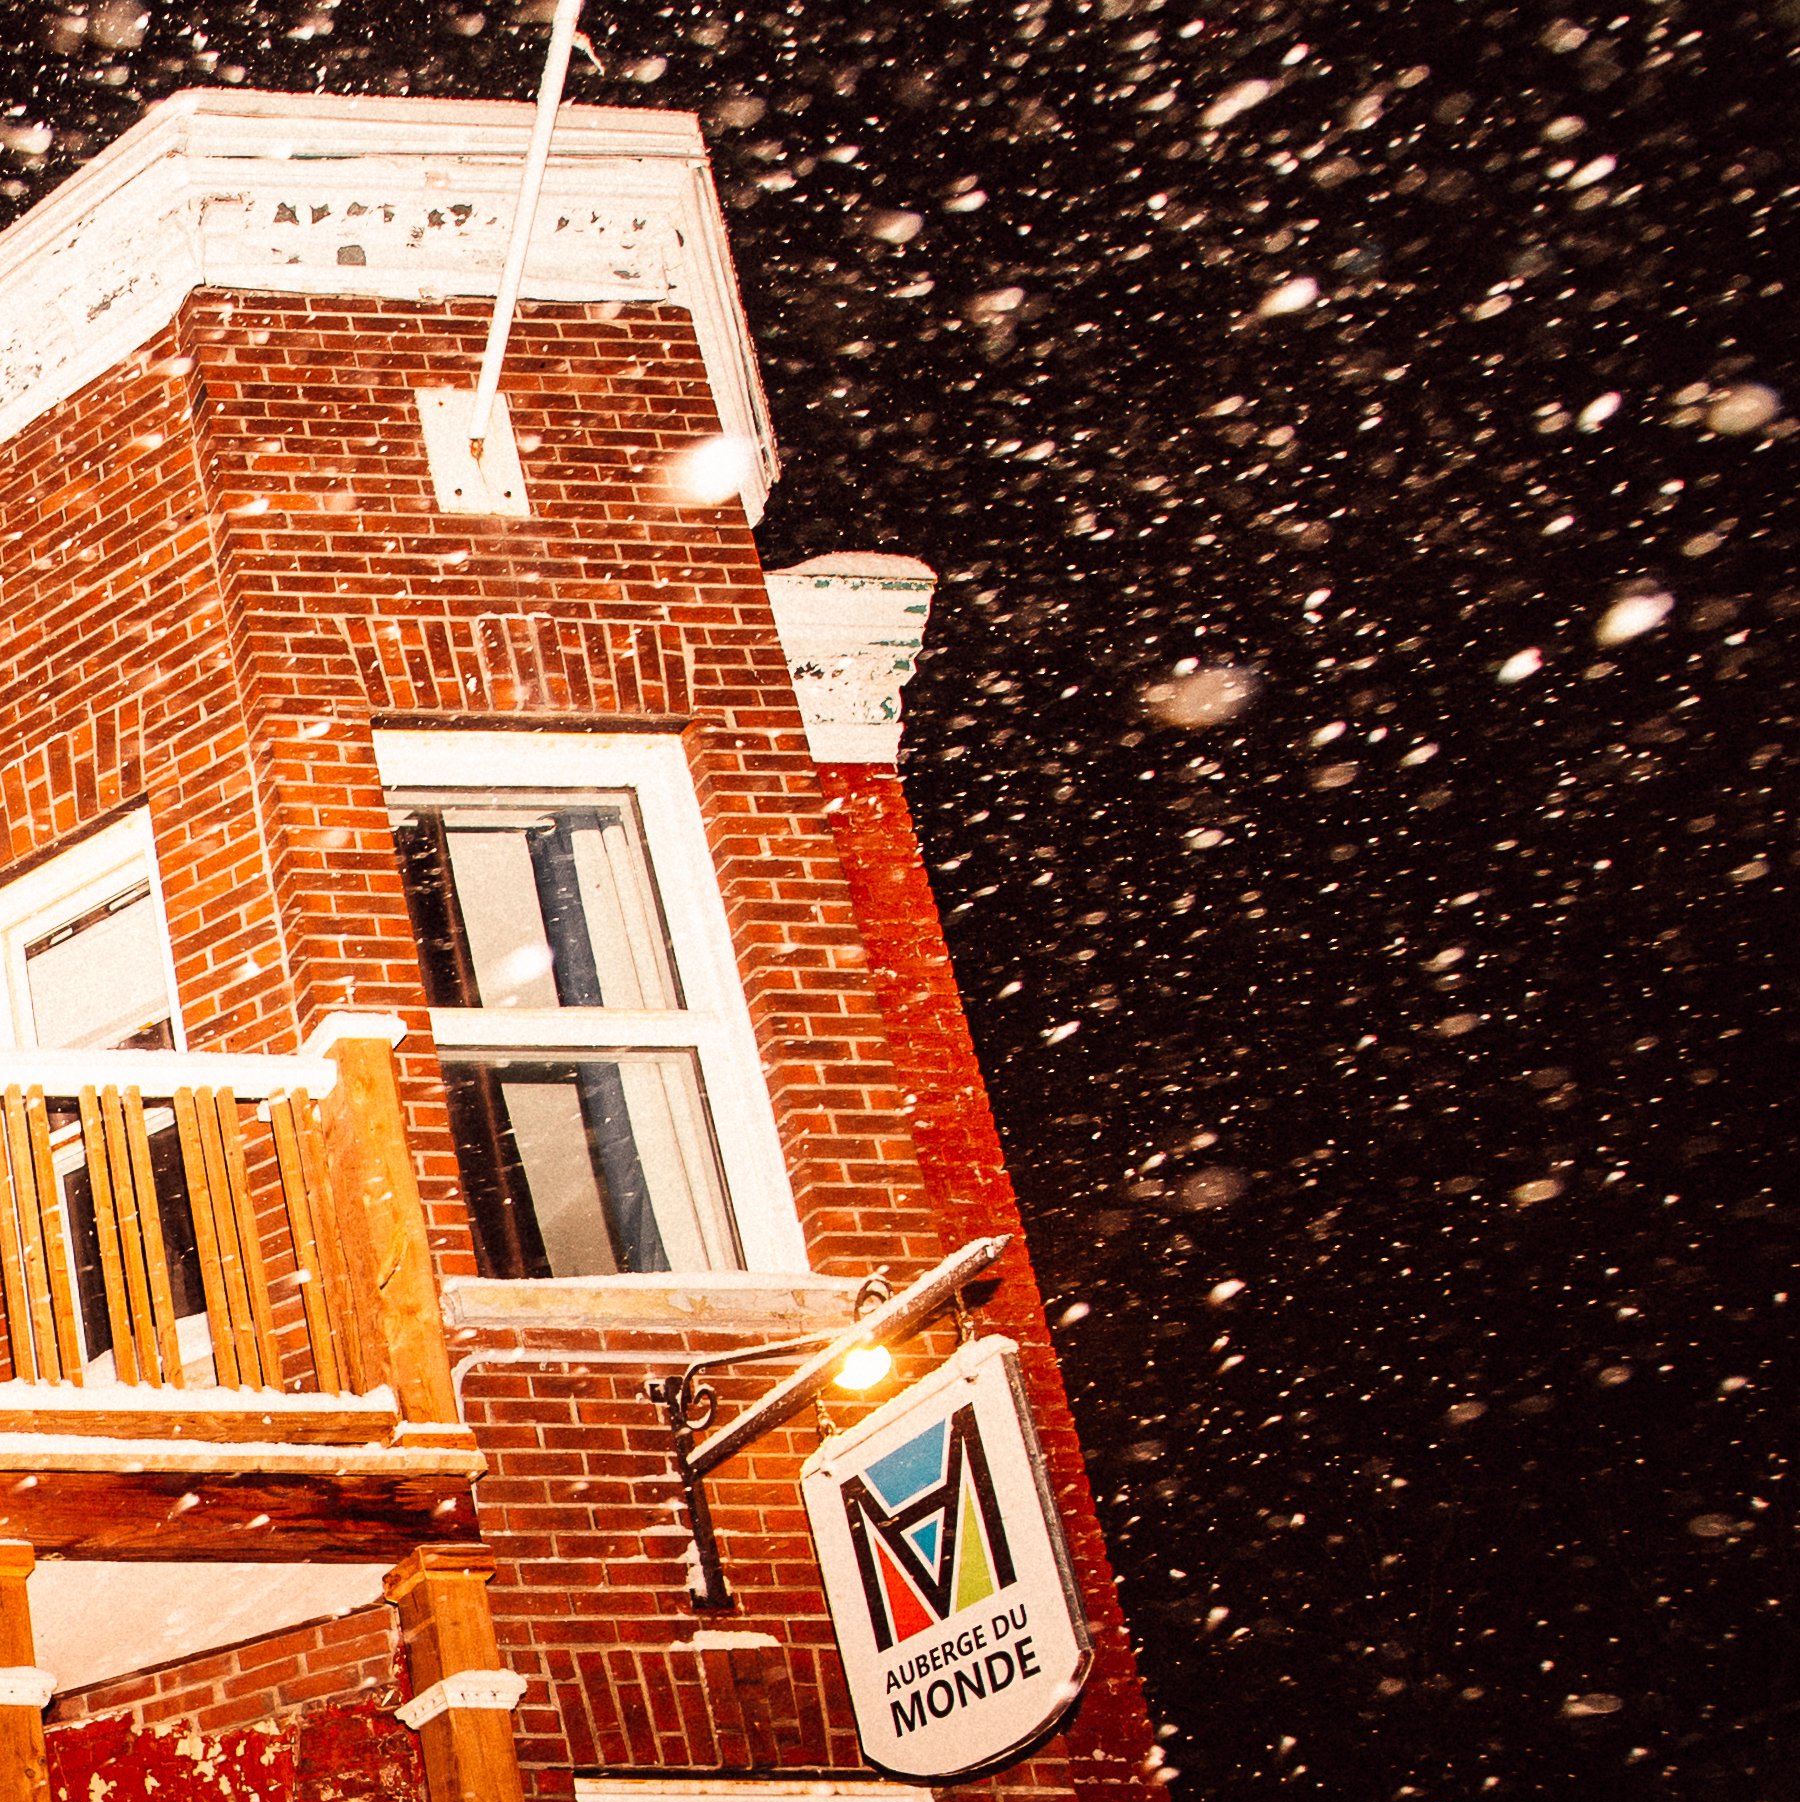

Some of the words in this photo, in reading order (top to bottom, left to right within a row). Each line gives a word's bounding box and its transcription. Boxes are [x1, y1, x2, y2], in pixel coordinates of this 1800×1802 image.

[886, 1624, 988, 1695] AUBERGE
[991, 1603, 1028, 1641] DU
[889, 1635, 1042, 1738] MONDE
